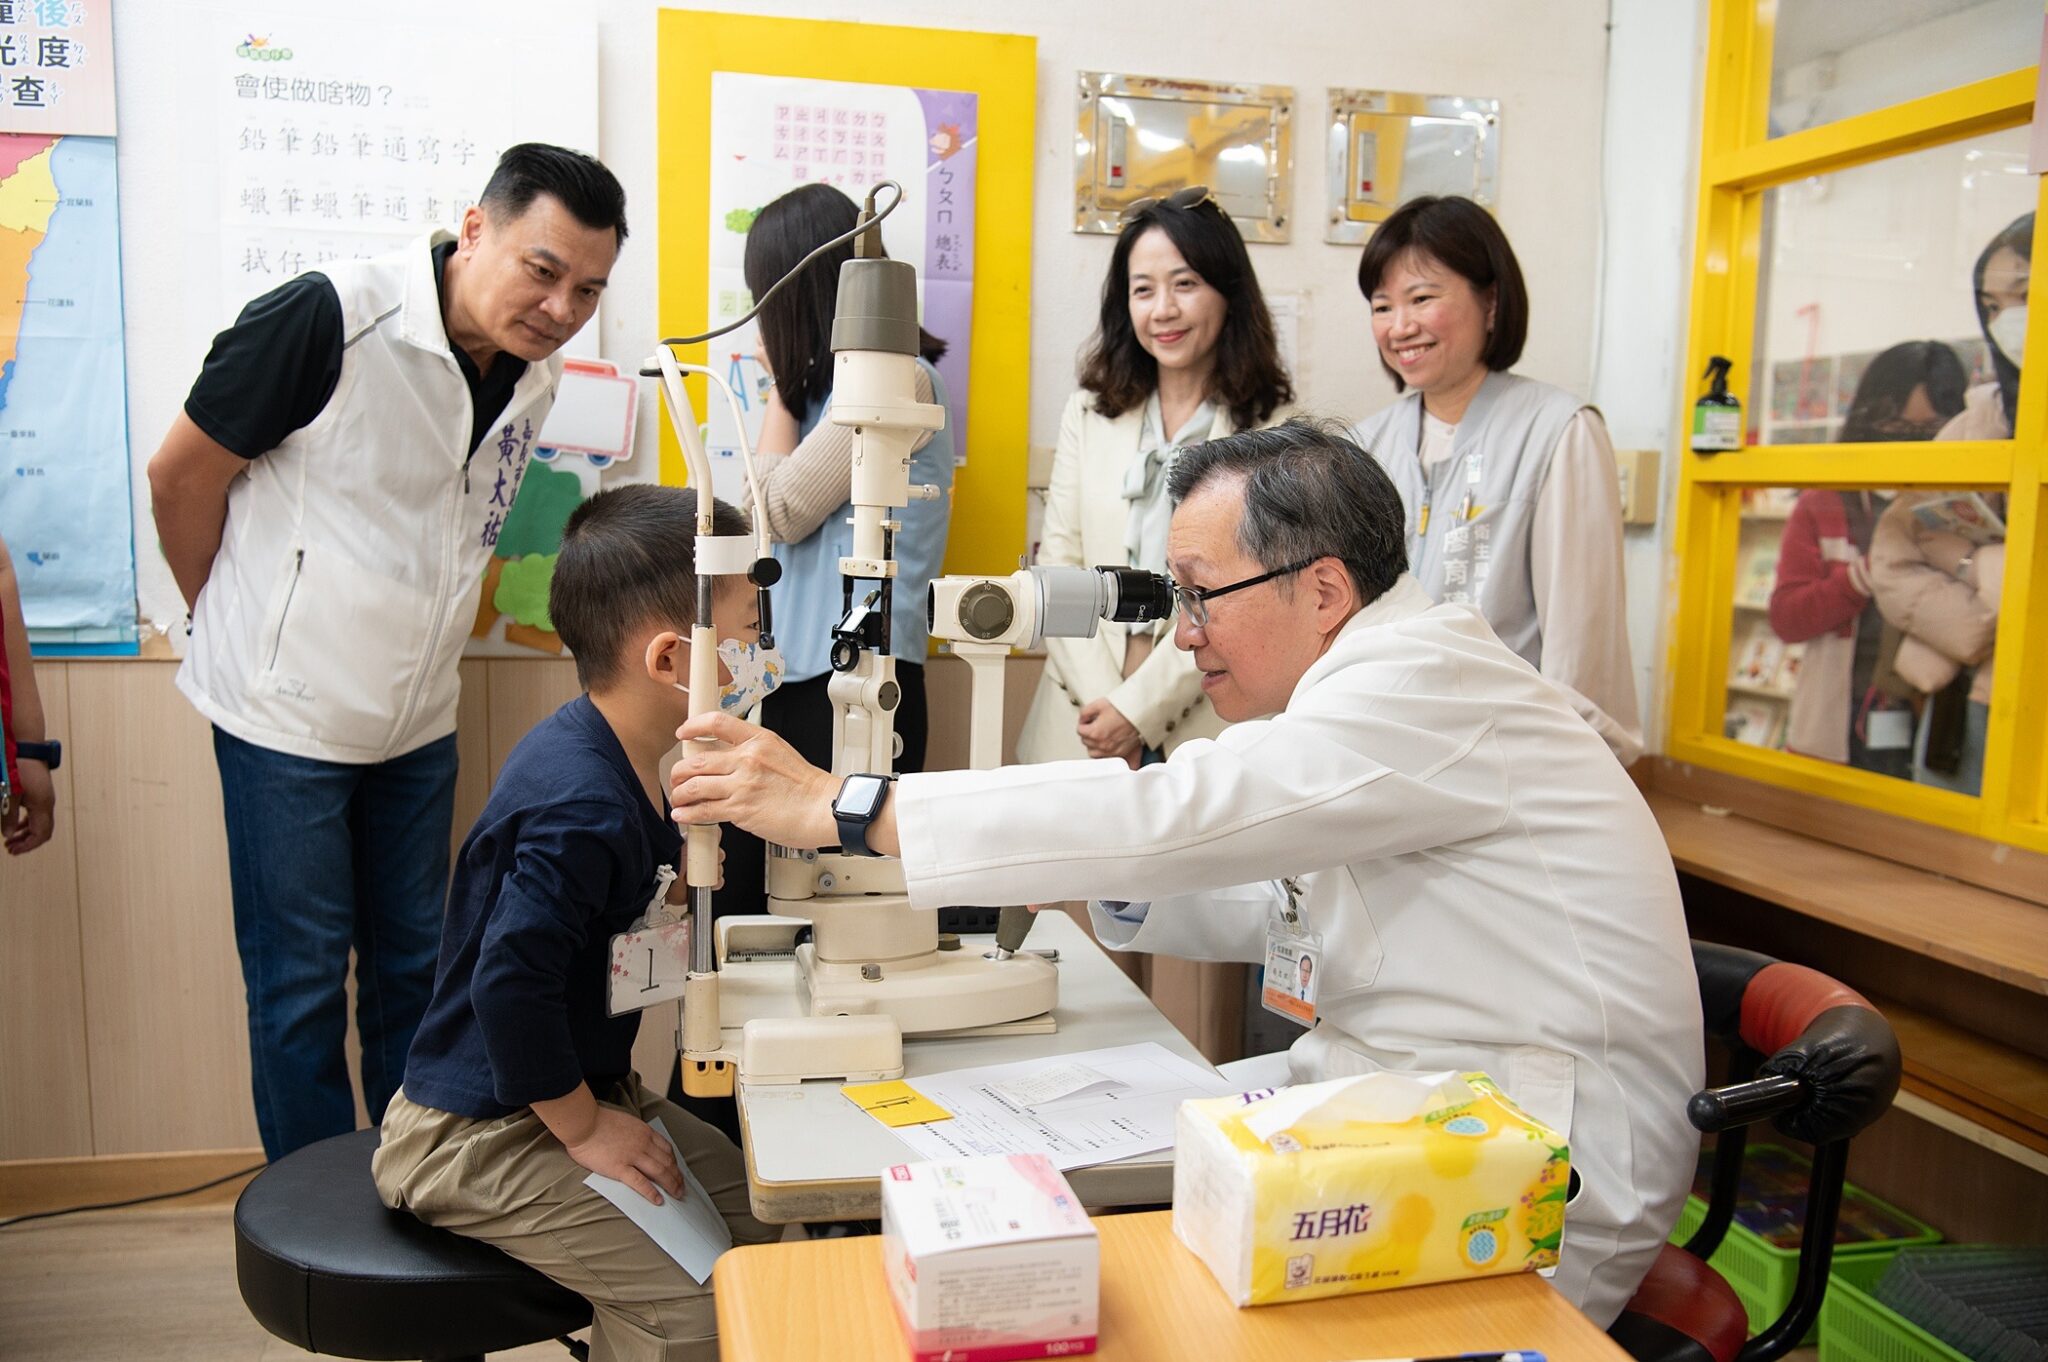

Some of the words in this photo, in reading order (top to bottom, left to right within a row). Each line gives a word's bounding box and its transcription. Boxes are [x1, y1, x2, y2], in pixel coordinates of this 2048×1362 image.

[11, 75, 45, 107] 查
[234, 73, 393, 107] 會使做啥物？
[481, 423, 521, 548] 黃大祐
[1289, 1203, 1371, 1242] 五月花
